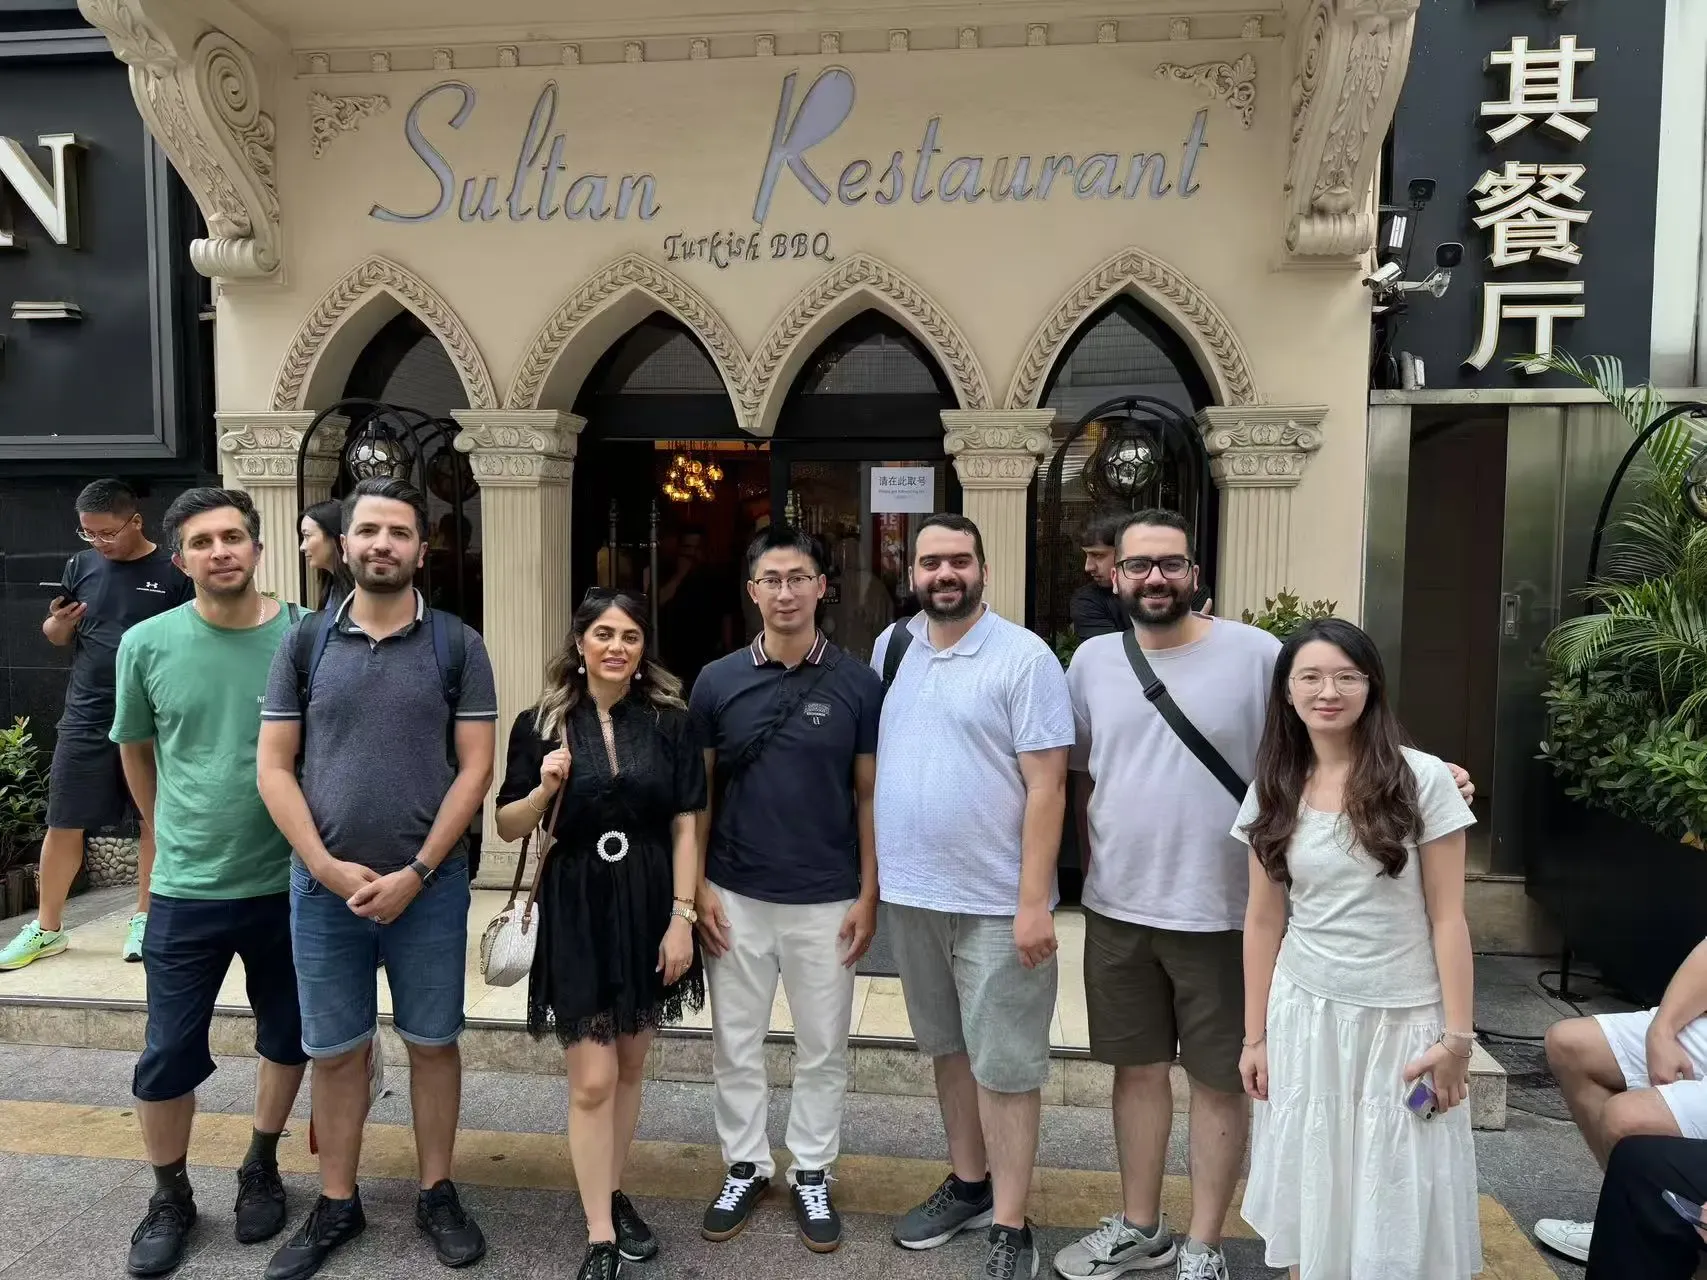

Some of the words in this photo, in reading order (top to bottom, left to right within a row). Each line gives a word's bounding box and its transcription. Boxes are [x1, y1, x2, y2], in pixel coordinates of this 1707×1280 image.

[369, 79, 662, 222] Sultan
[752, 65, 1209, 226] Restaurant
[663, 231, 760, 269] Turkish
[770, 231, 836, 262] BBQ
[878, 475, 927, 487] 请在此取号
